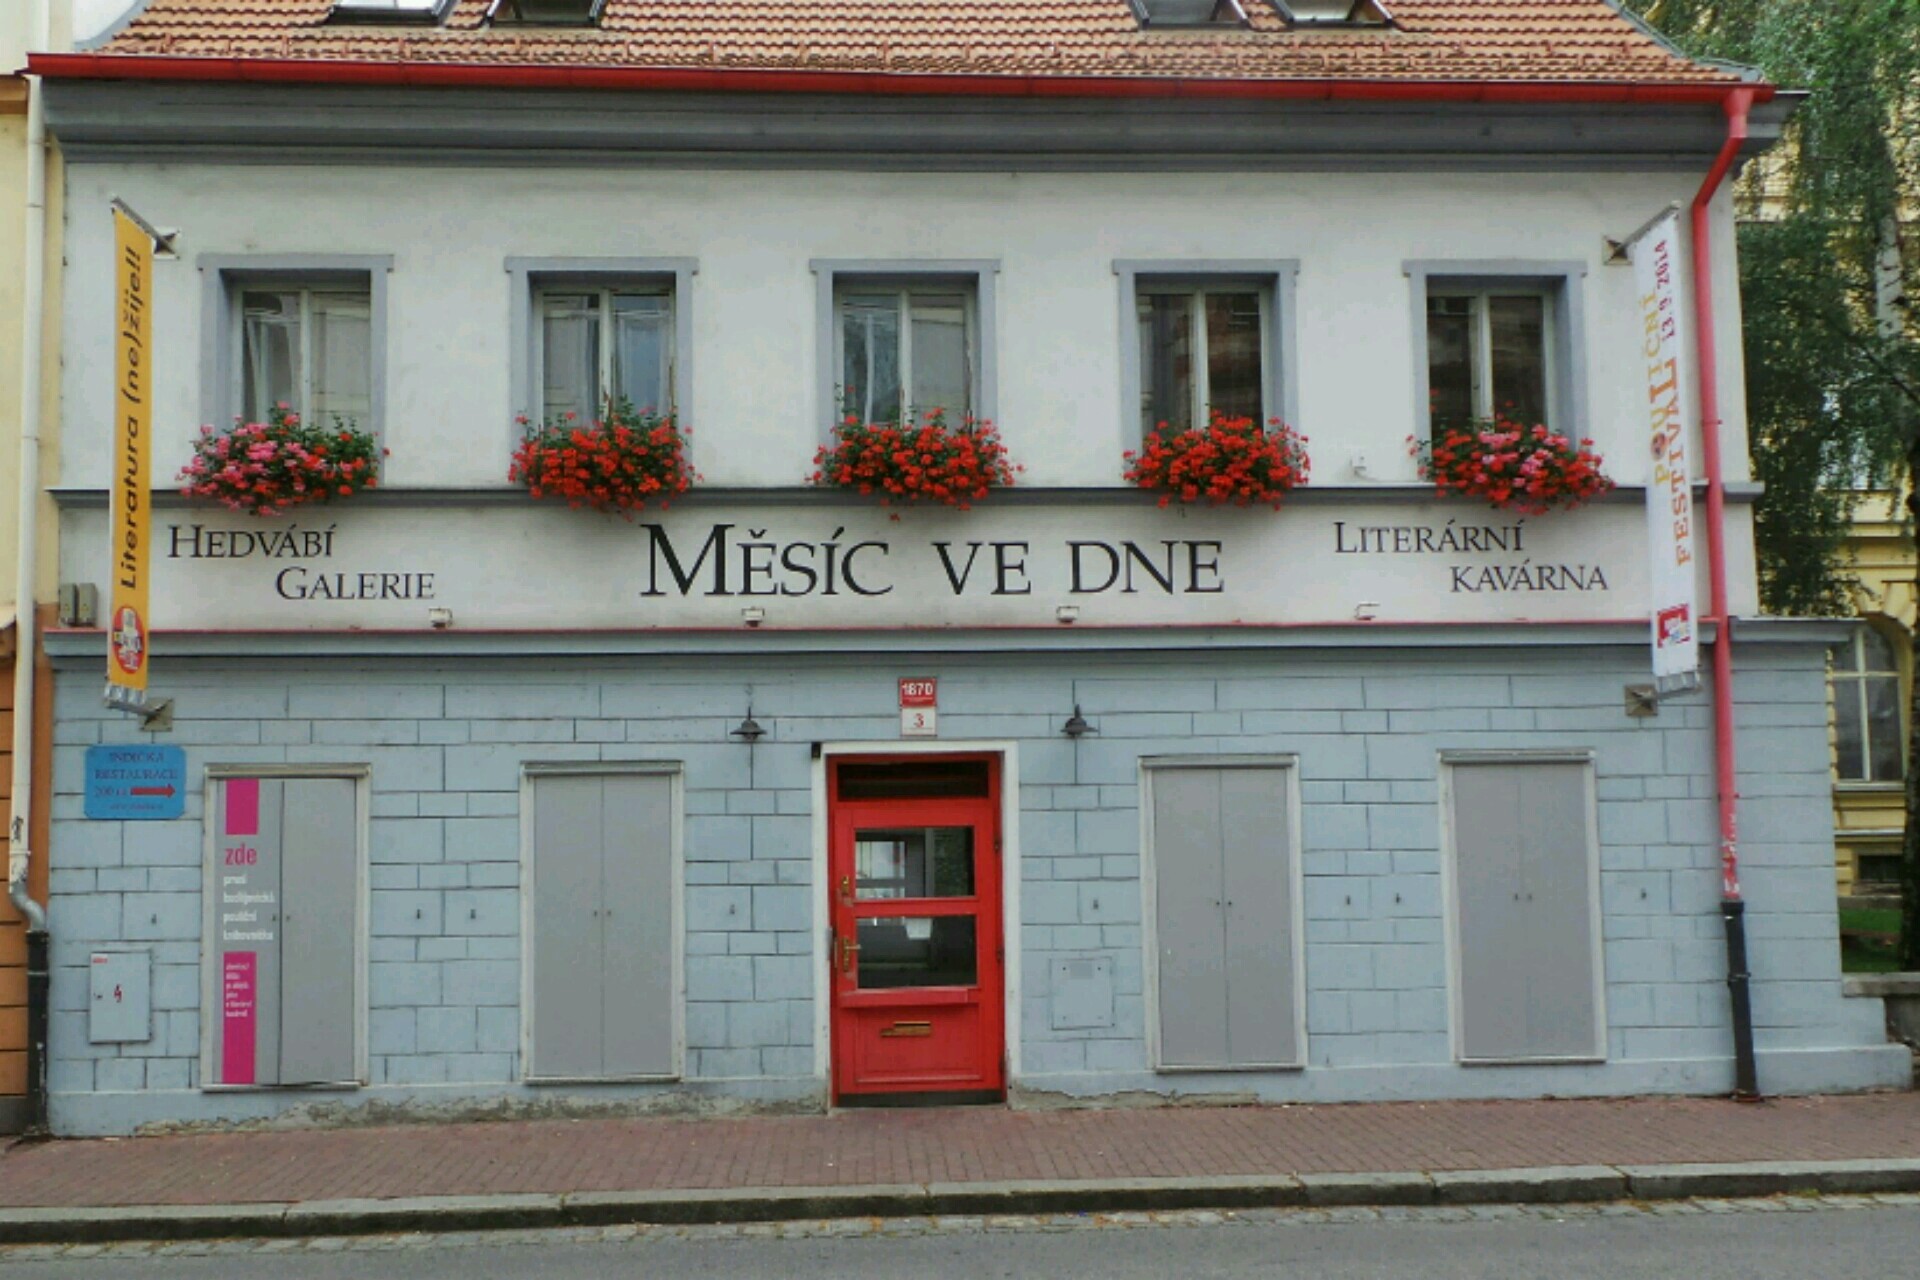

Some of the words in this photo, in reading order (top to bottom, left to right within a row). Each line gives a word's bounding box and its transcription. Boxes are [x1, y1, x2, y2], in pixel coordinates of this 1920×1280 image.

[1649, 357, 1691, 567] FESTIVAL
[121, 415, 138, 589] Literatura
[275, 566, 435, 600] GALERIE
[932, 541, 1032, 596] VE
[1065, 540, 1225, 595] DNE
[1449, 558, 1609, 592] KAVÁRNA
[902, 682, 933, 696] 1870
[913, 712, 925, 728] 3
[225, 843, 257, 866] zde
